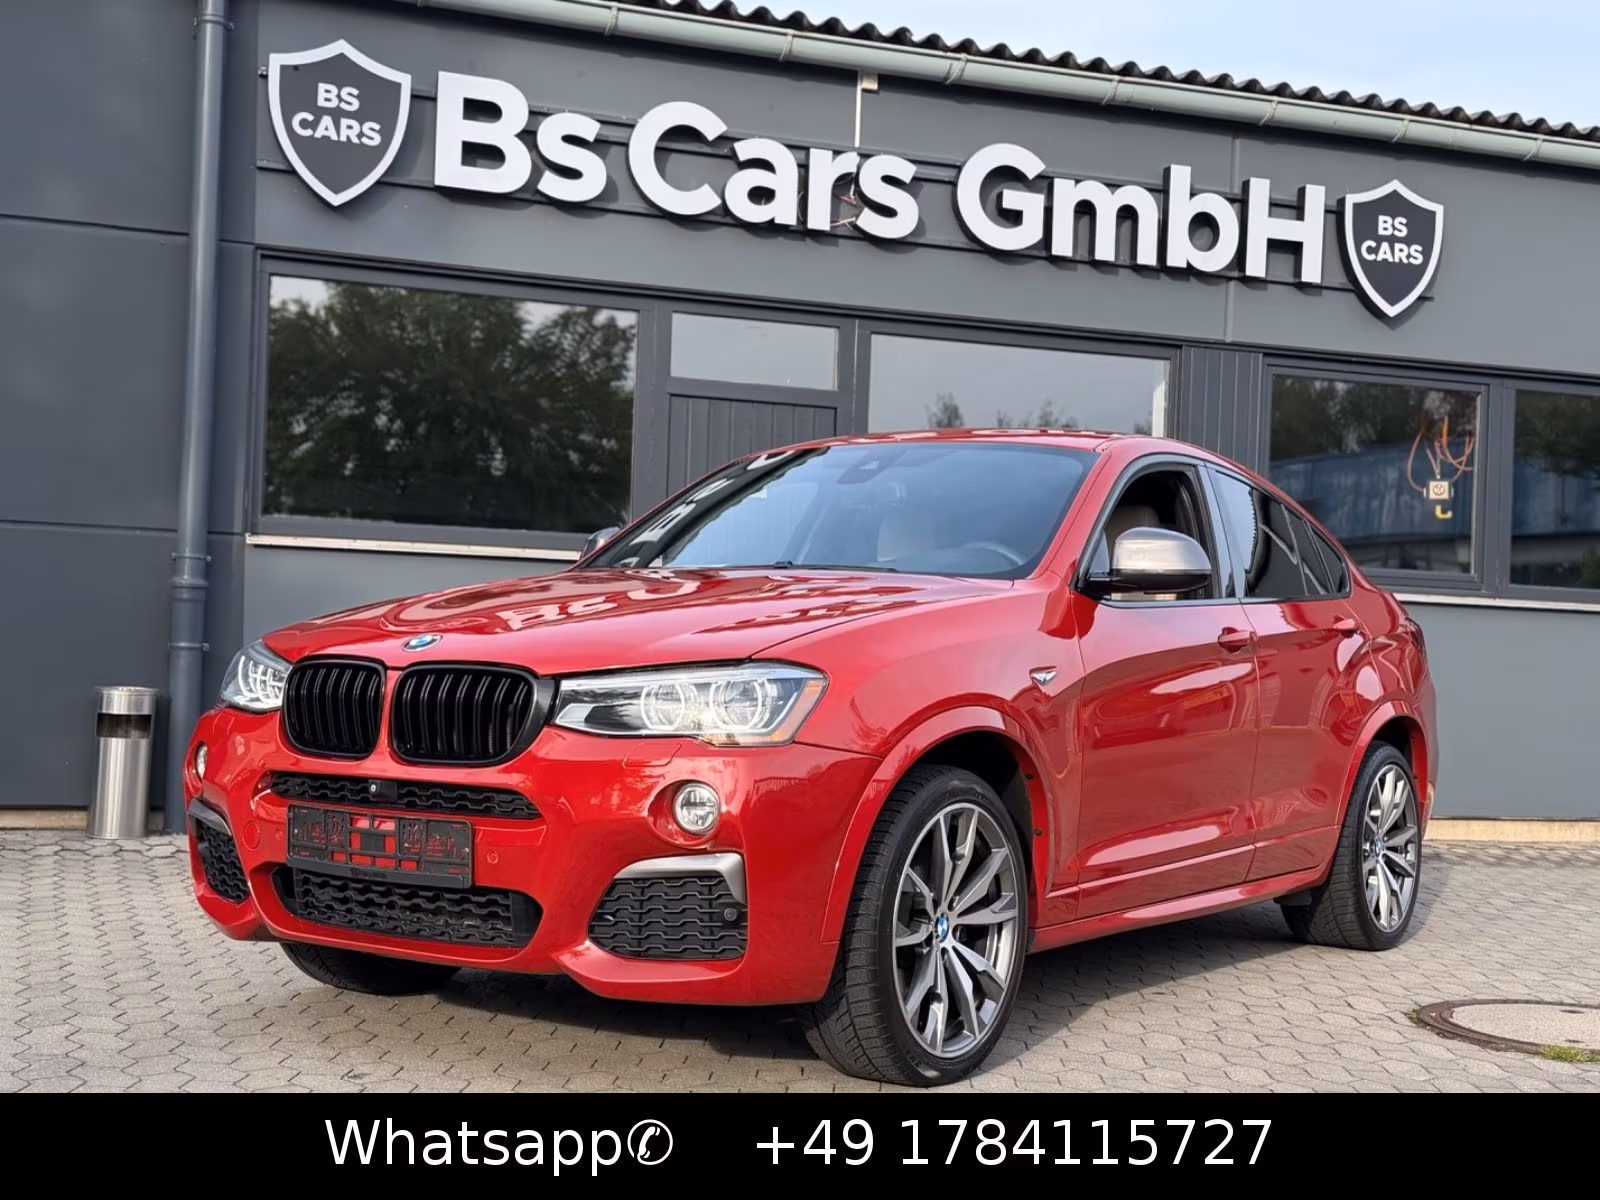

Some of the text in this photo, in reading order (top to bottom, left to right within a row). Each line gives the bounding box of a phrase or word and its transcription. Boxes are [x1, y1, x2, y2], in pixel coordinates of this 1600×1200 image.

[317, 83, 360, 112] BS
[291, 111, 382, 147] CARS
[434, 70, 1326, 284] Bs Cars GmbH
[1377, 214, 1408, 238] BS
[1360, 239, 1424, 265] CARS
